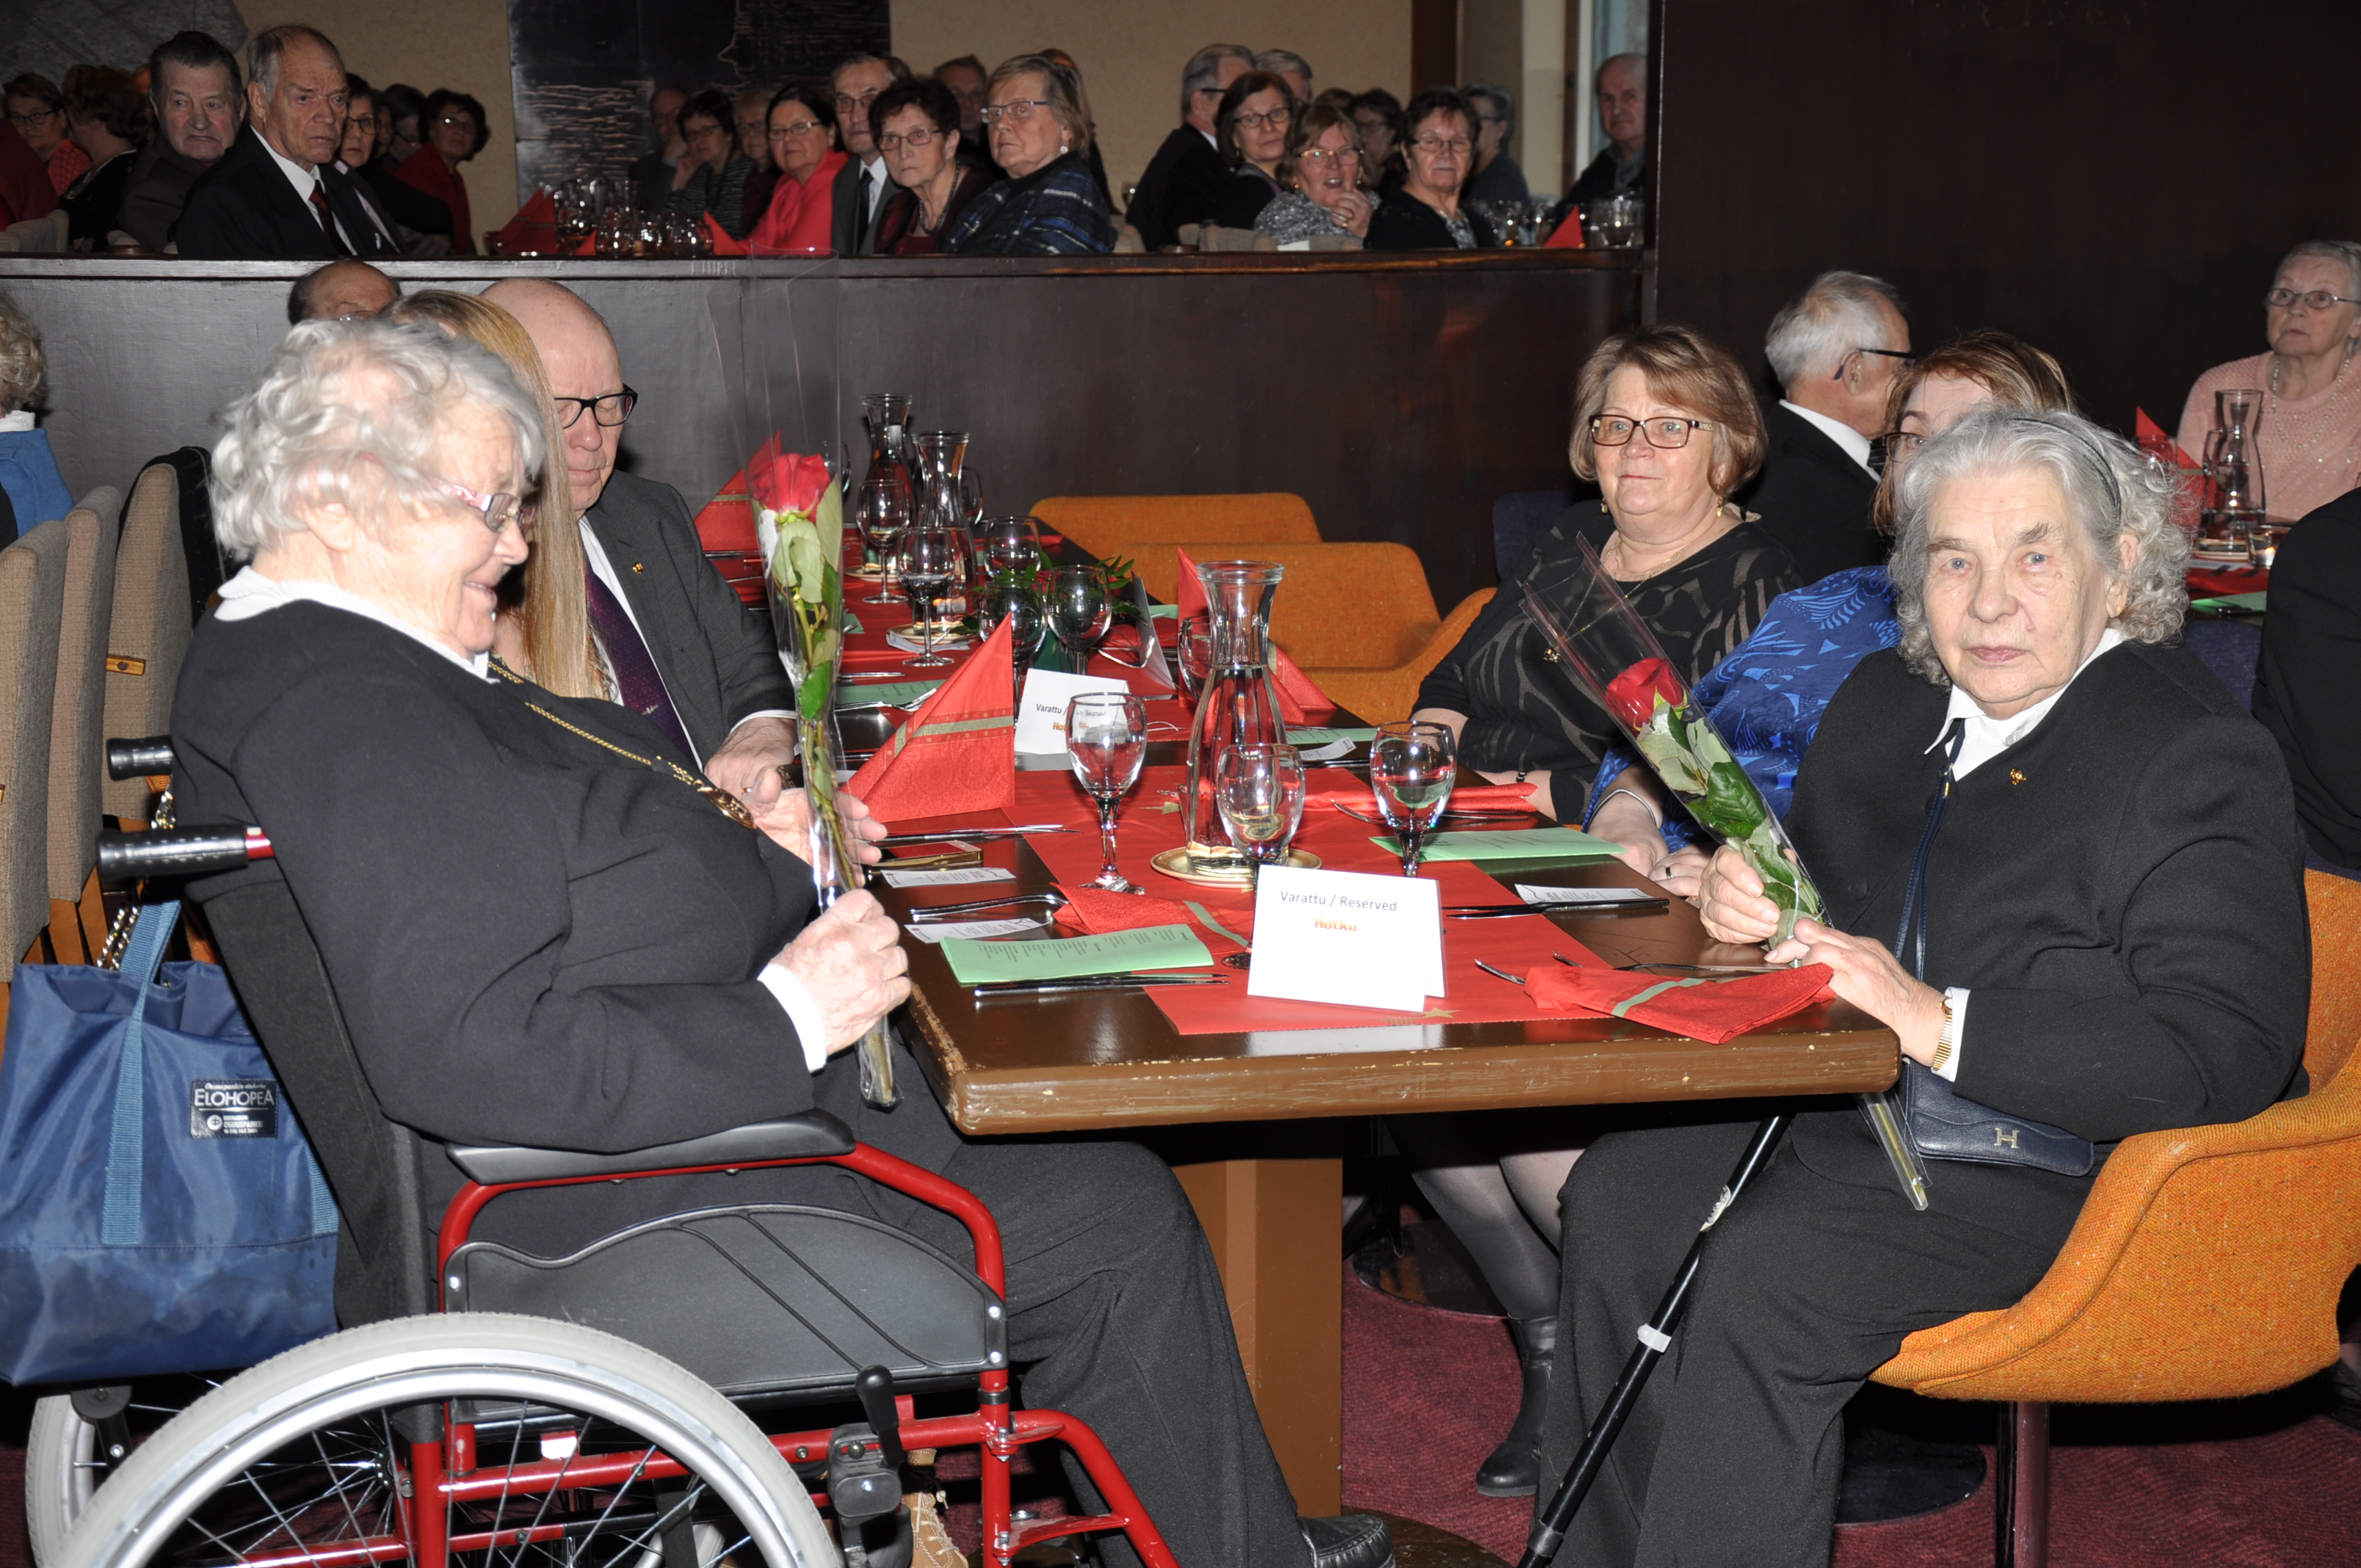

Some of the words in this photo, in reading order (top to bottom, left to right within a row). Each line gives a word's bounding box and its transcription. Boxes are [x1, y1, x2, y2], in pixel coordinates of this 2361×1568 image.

[1036, 703, 1062, 714] Varattu
[1280, 890, 1326, 905] Varattu
[1340, 896, 1397, 912] Reserved
[194, 1089, 275, 1106] ELOHOPEA
